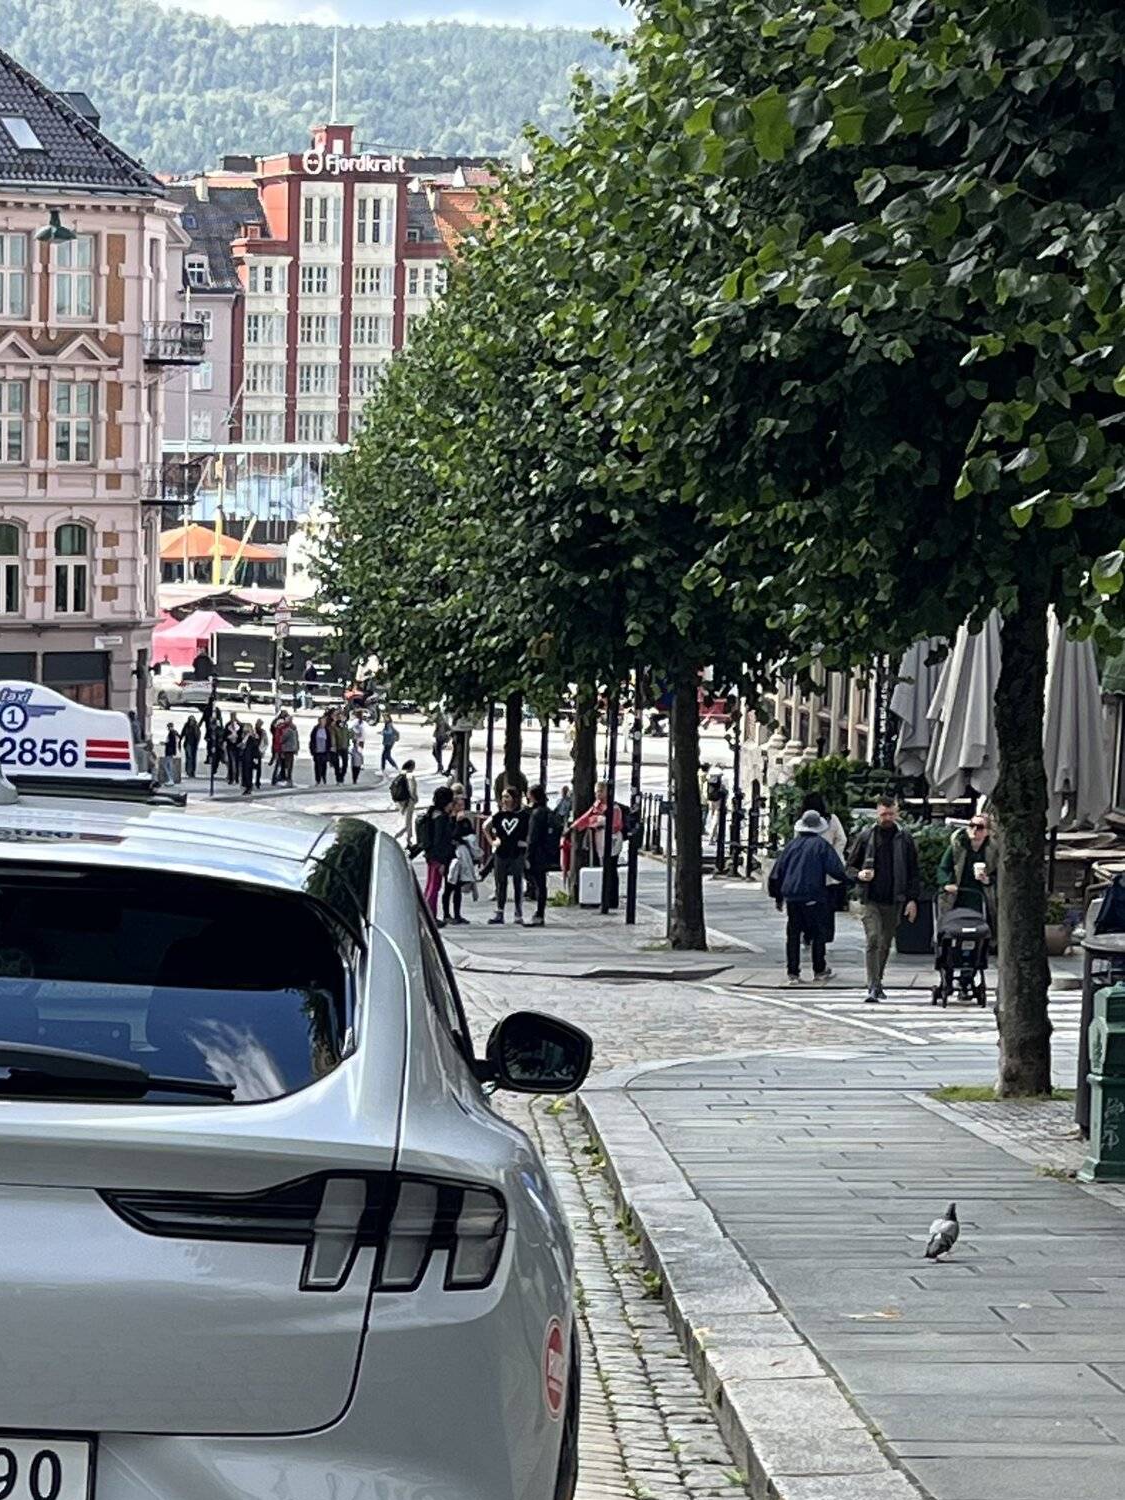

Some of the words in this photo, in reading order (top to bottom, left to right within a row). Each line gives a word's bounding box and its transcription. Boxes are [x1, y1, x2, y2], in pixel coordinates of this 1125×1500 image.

[325, 153, 405, 175] Fjordkraft
[0, 687, 33, 703] taxi
[7, 708, 18, 725] 1
